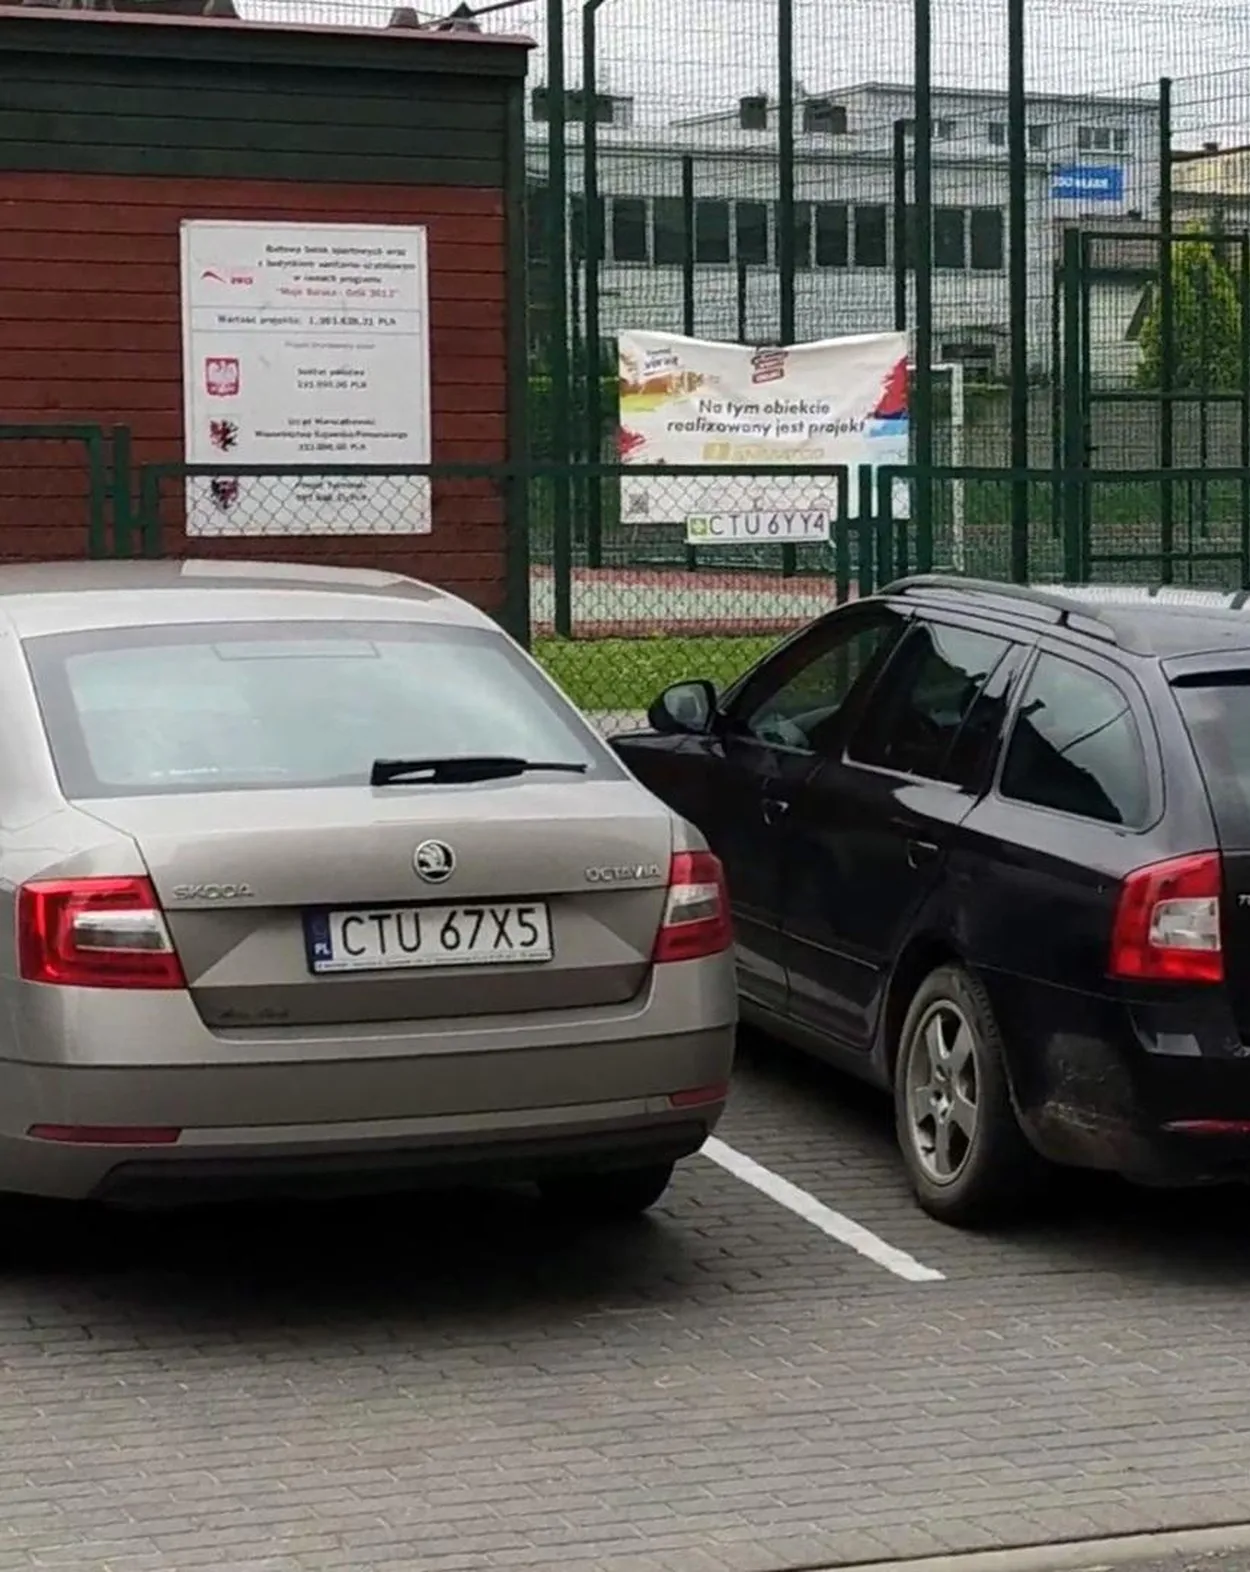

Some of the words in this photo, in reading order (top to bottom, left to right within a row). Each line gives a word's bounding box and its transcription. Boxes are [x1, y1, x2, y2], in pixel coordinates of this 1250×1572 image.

[699, 400, 721, 414] Na
[726, 400, 760, 418] tym
[763, 399, 830, 415] obiekcie
[667, 418, 771, 436] realizowany
[775, 419, 804, 437] jest
[808, 420, 865, 438] projekt
[709, 515, 761, 536] CTU
[767, 514, 826, 535] 6YY4
[342, 910, 422, 957] CTU
[440, 907, 539, 951] 67X5
[315, 943, 331, 956] PL
